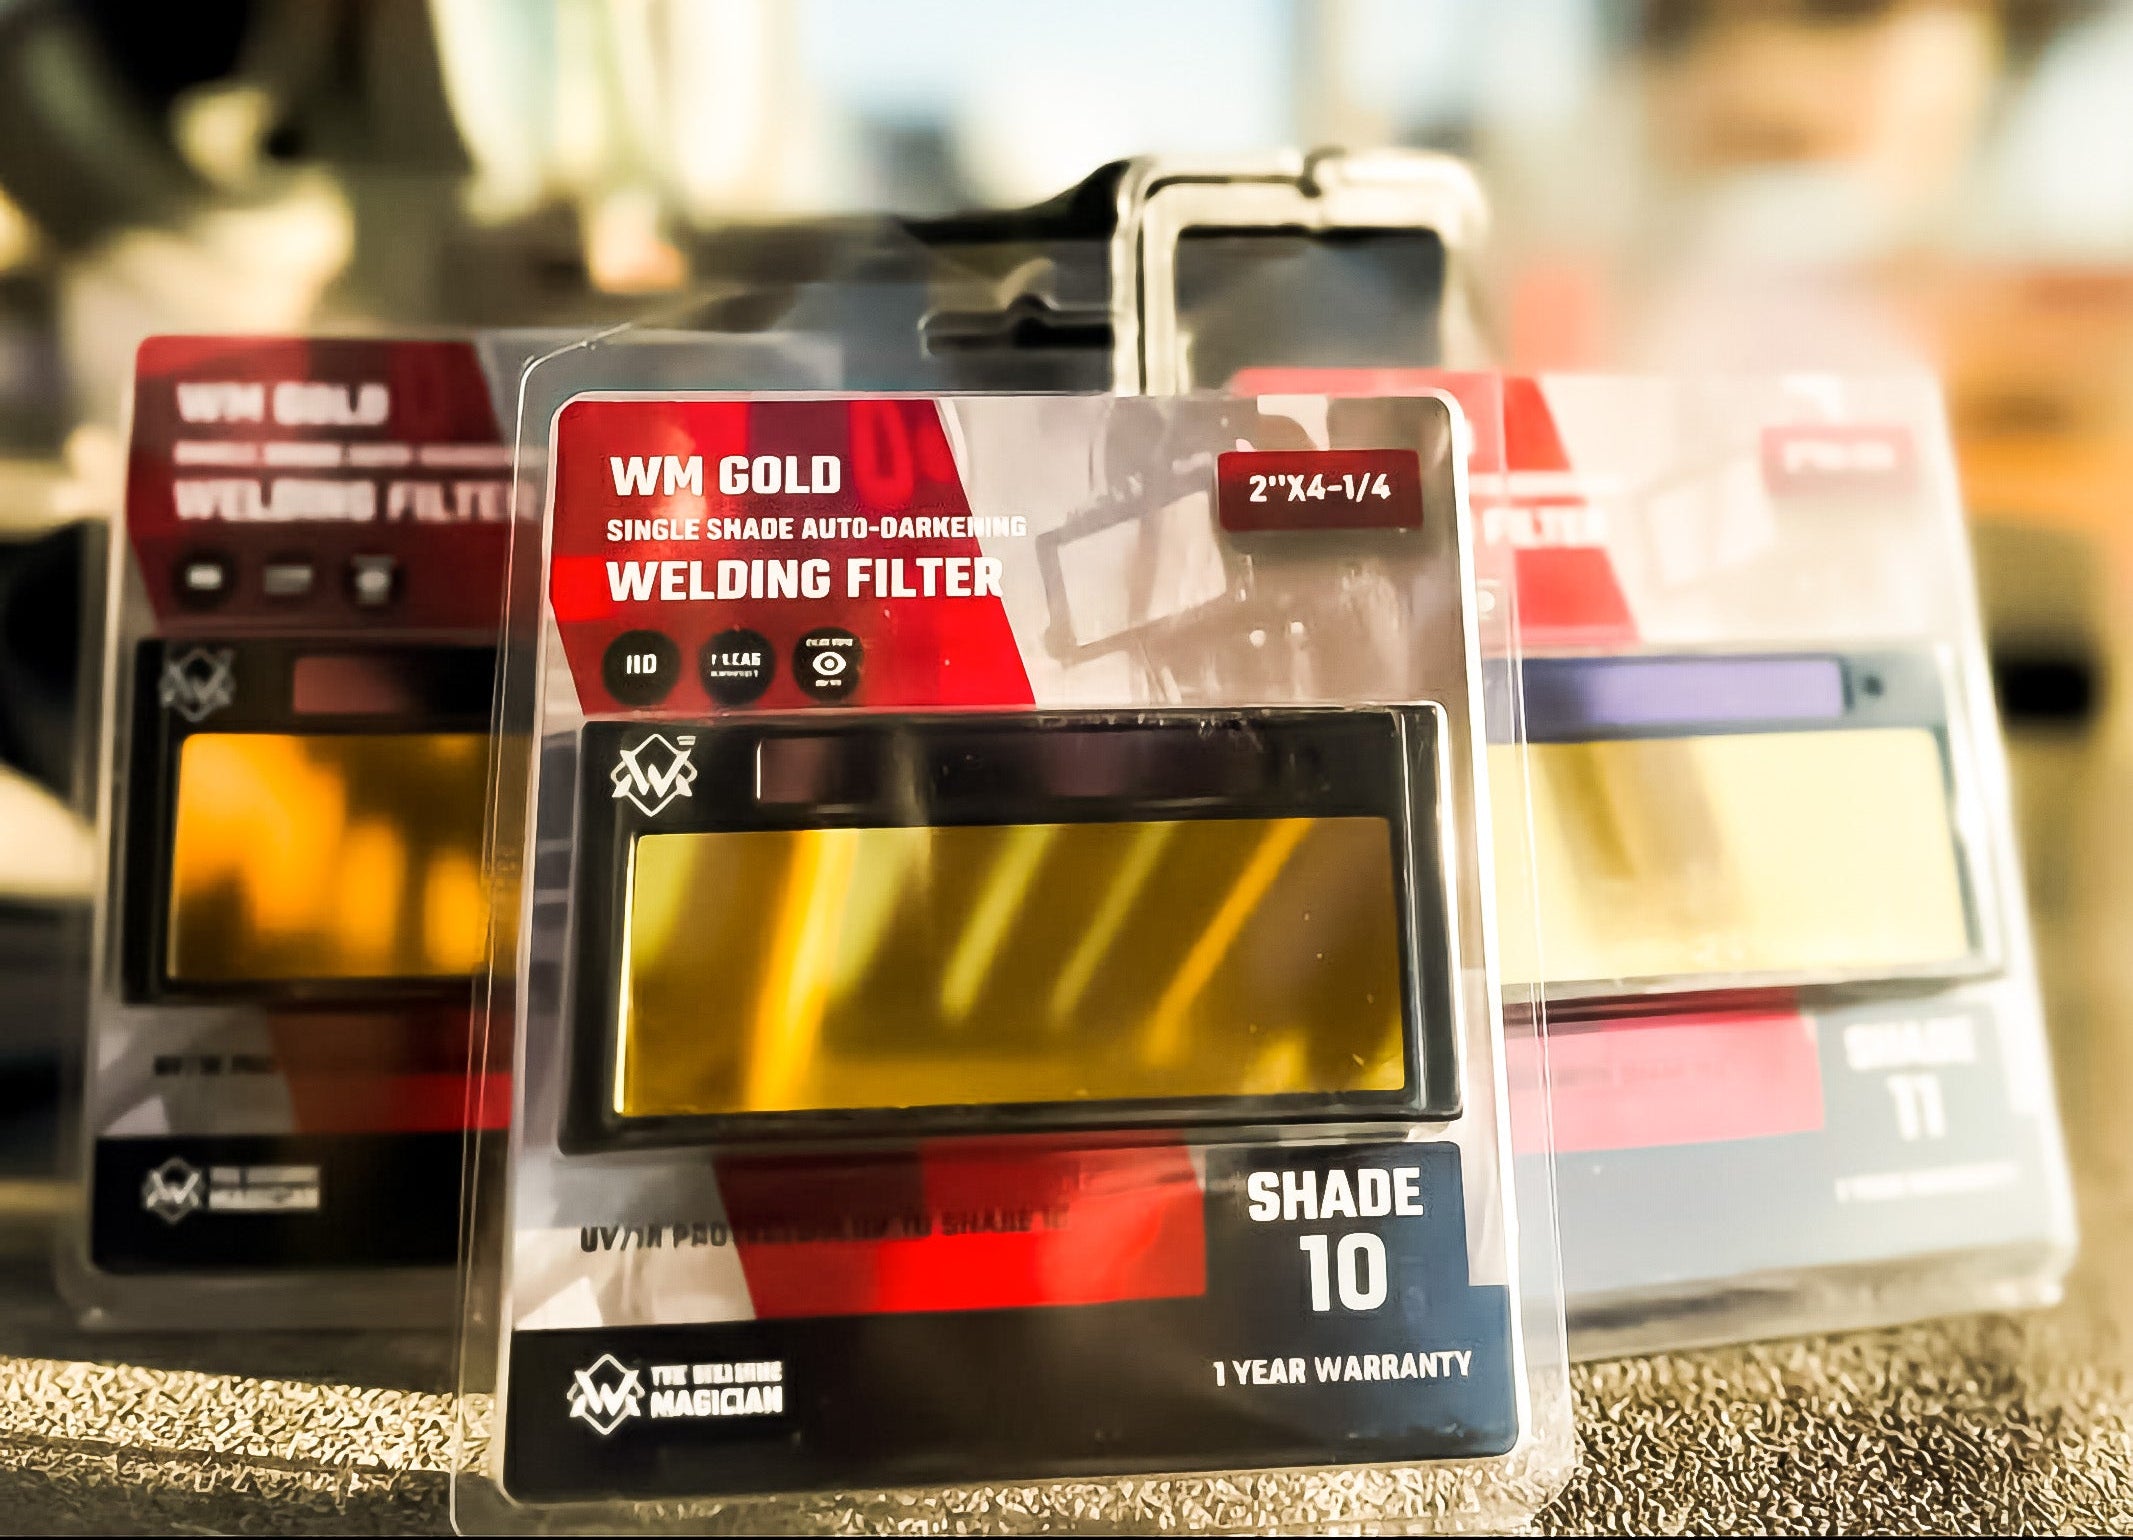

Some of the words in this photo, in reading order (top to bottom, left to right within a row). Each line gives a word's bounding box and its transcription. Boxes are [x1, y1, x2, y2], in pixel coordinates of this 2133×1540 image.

[609, 455, 704, 496] WM
[718, 455, 842, 496] GOLD
[606, 517, 700, 541] SINGLE
[706, 516, 794, 540] SHADE
[800, 515, 1028, 540] AUTO-DARKENING
[606, 558, 832, 602] WELDING
[846, 556, 1004, 599] FILTER
[1248, 1167, 1424, 1222] SHADE
[1300, 1232, 1388, 1312] 10
[1213, 1360, 1226, 1387] 1
[1232, 1357, 1306, 1385] YEAR
[1315, 1350, 1472, 1383] WARRANTY
[651, 1385, 784, 1418] MAGICIAN
